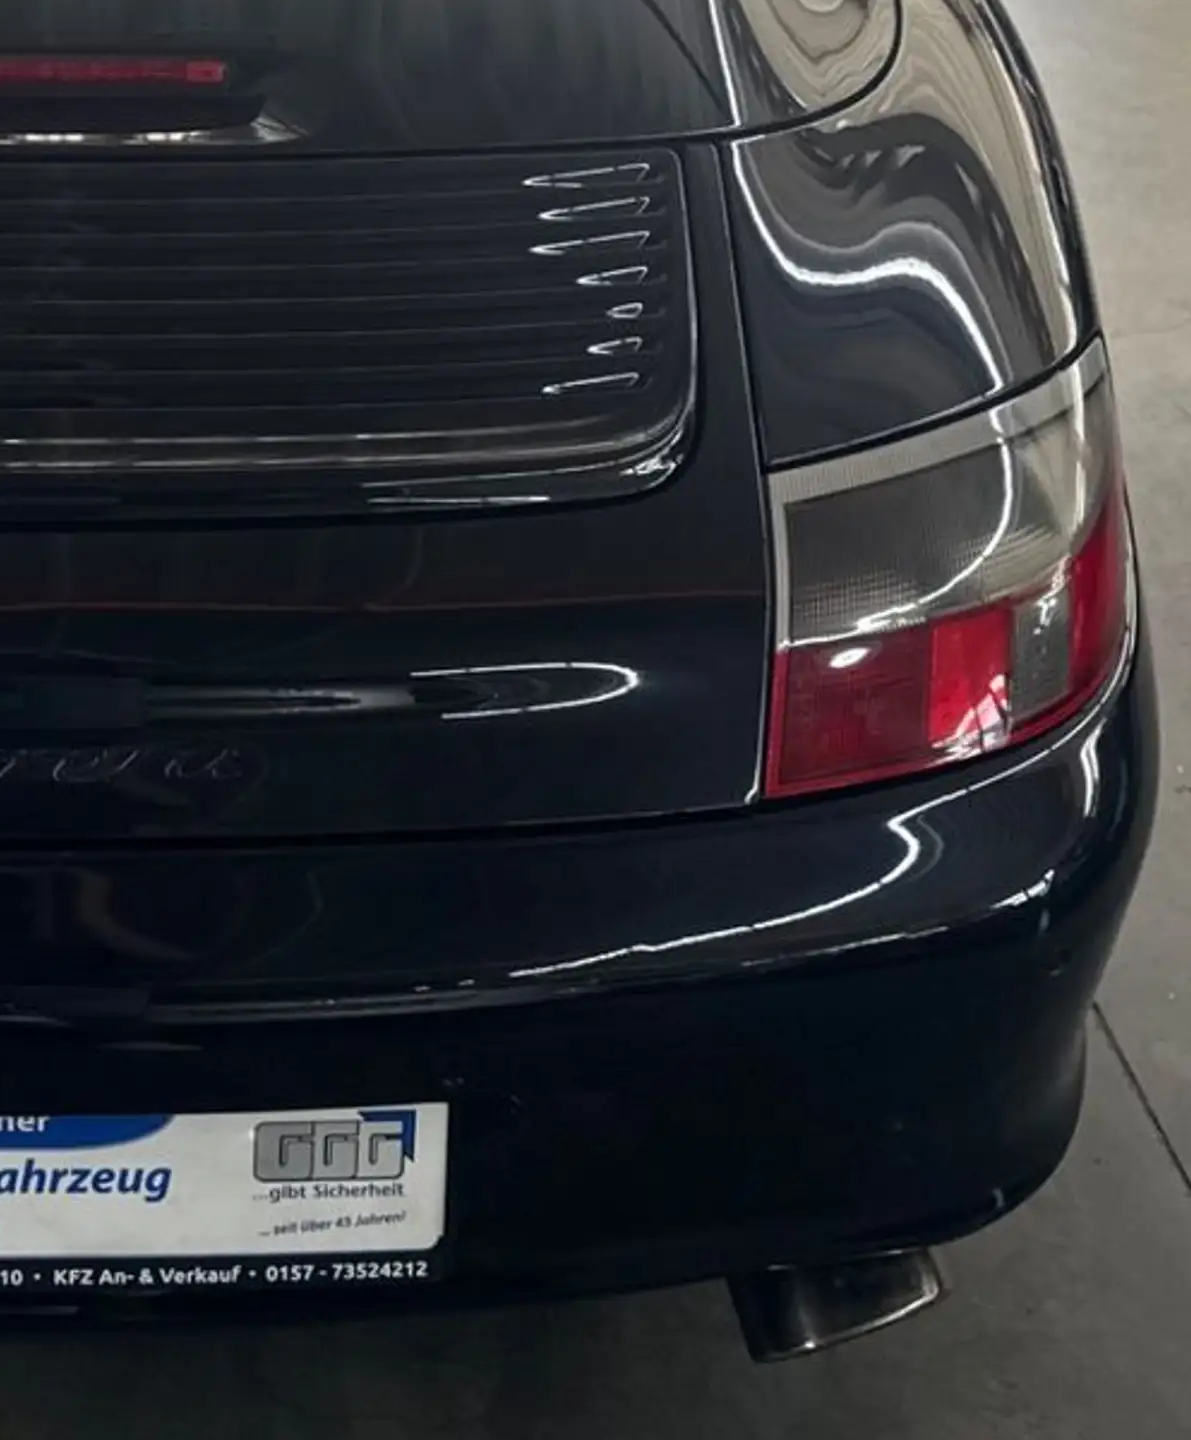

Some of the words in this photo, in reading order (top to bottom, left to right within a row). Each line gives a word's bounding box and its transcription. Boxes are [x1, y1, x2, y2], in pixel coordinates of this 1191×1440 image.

[313, 1182, 405, 1198] Sicherheit
[0, 1269, 24, 1286] 10
[53, 1269, 94, 1286] KFZ
[99, 1269, 134, 1285] An-
[138, 1268, 154, 1284] &
[158, 1265, 242, 1284] Verkauf
[265, 1265, 314, 1282] 0157
[332, 1262, 428, 1279] 73524212
